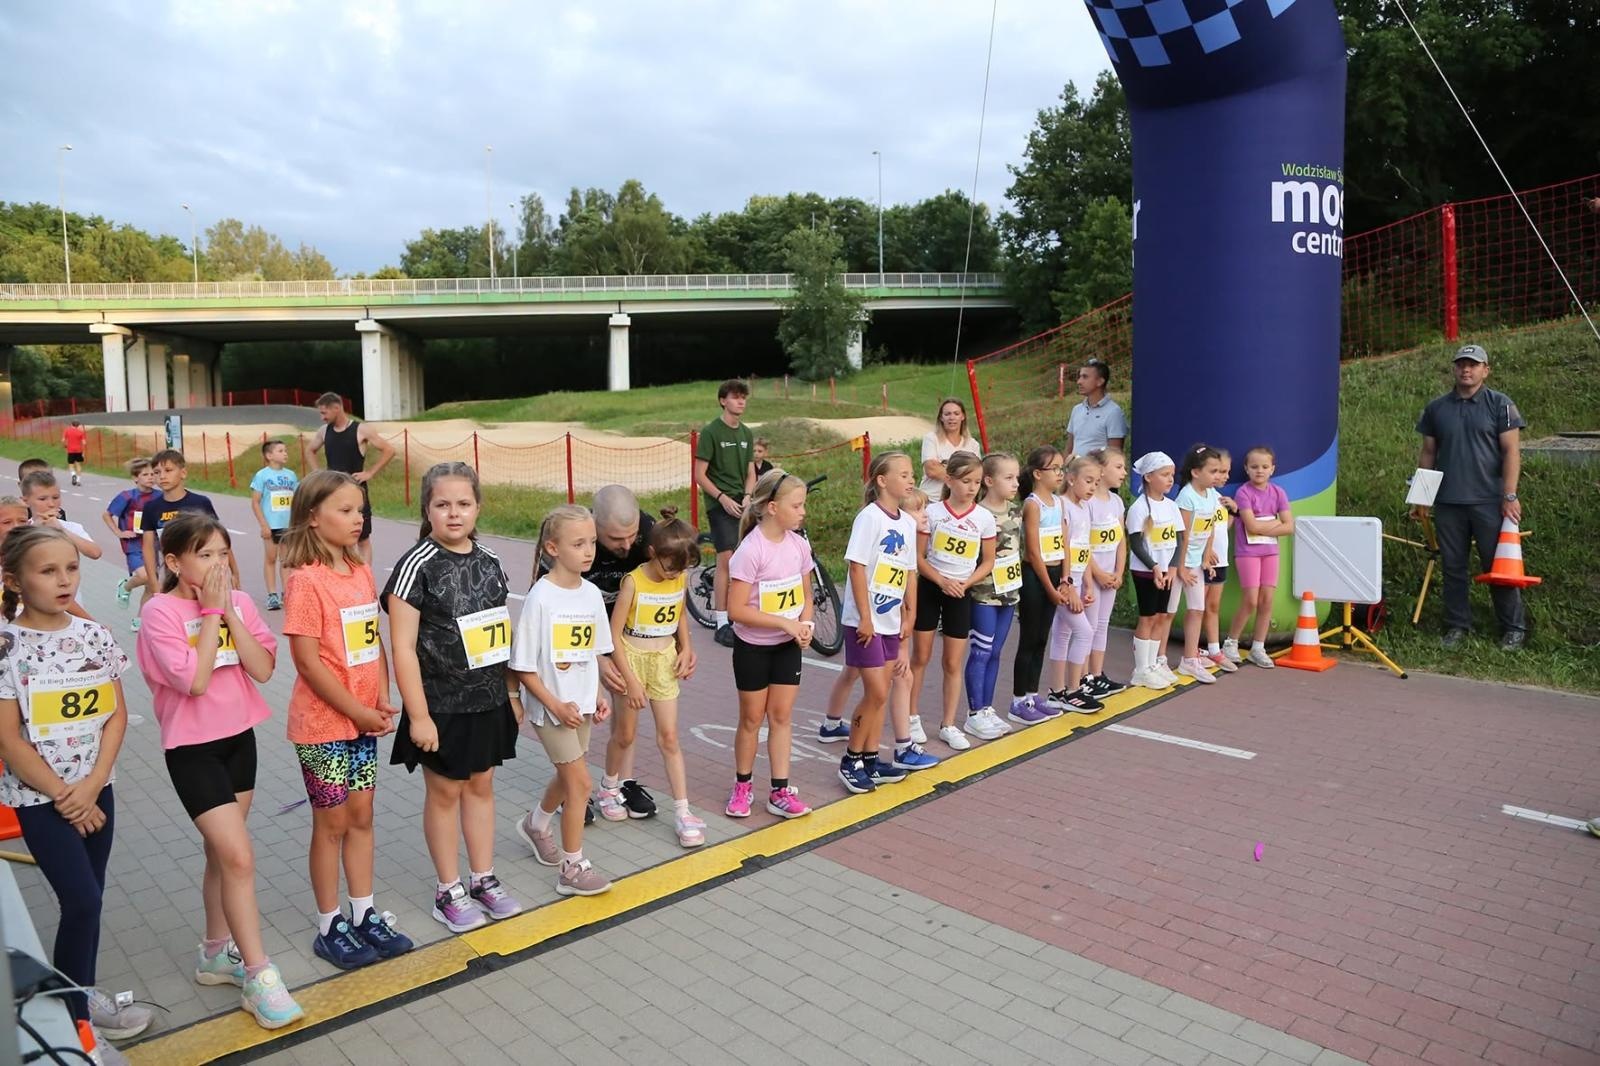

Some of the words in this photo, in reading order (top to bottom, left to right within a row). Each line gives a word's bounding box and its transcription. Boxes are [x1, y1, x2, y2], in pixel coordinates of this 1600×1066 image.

[1281, 163, 1337, 181] Wodzisław
[1100, 529, 1116, 543] 90
[1161, 526, 1175, 540] 66
[944, 536, 967, 555] 58
[888, 567, 904, 587] 73
[776, 588, 797, 610] 71
[654, 604, 676, 624] 65
[482, 622, 506, 648] 77
[570, 625, 592, 647] 59
[60, 688, 99, 719] 82
